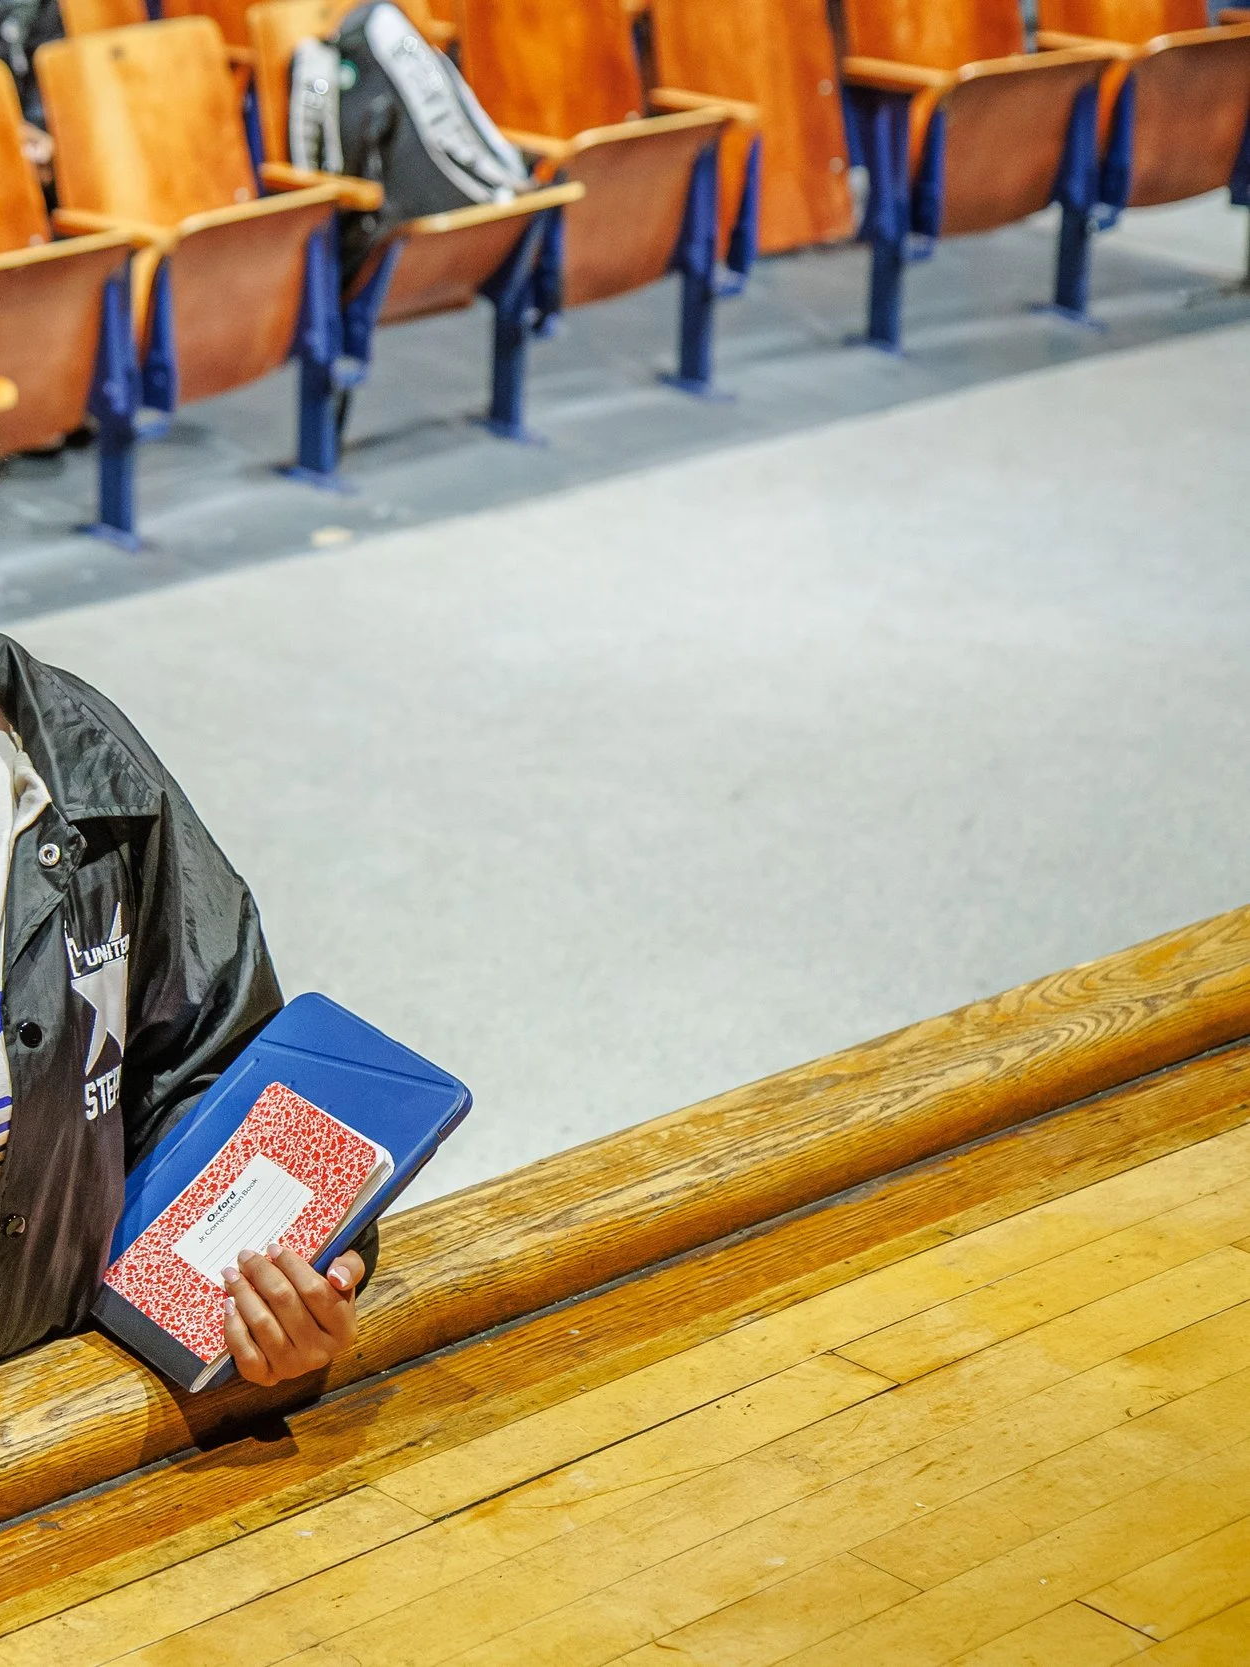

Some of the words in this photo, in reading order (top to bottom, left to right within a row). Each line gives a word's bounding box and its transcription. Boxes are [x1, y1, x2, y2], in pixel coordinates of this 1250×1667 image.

[204, 1195, 244, 1236] Composition
[241, 1178, 258, 1196] Book
[207, 1190, 237, 1222] Oxford
